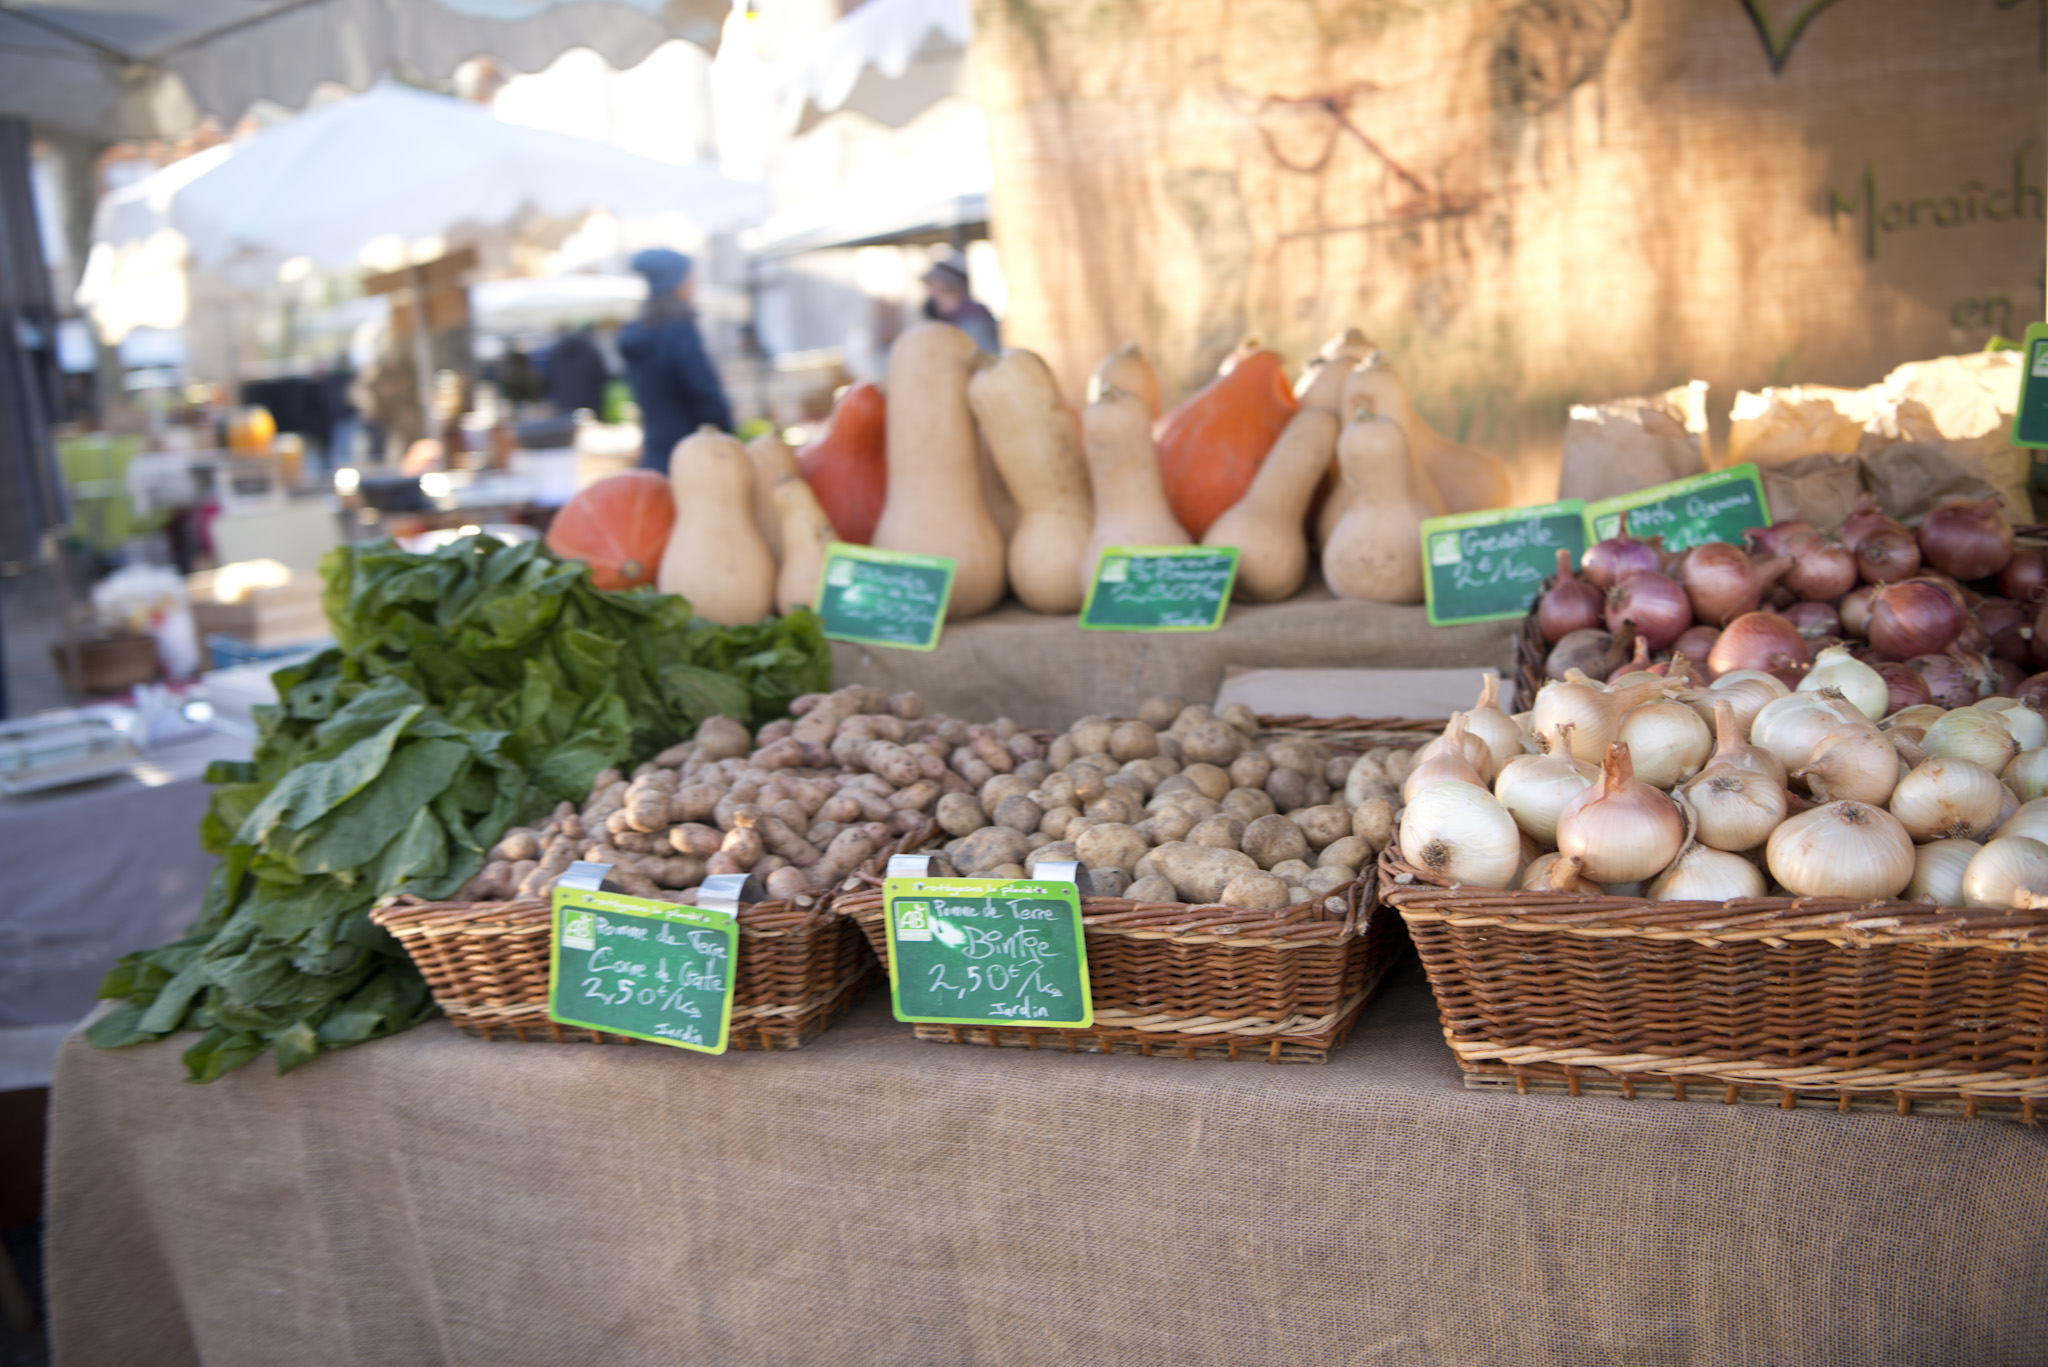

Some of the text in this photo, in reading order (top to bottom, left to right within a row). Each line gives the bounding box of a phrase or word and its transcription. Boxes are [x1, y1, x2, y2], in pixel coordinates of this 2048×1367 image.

[912, 881, 1048, 897] Protégeons la planète
[983, 897, 1004, 919] de
[1005, 897, 1060, 921] Terre
[655, 922, 688, 945] de
[961, 925, 1063, 965] Bintje
[655, 957, 673, 983] de
[988, 995, 1050, 1018] Jardin
